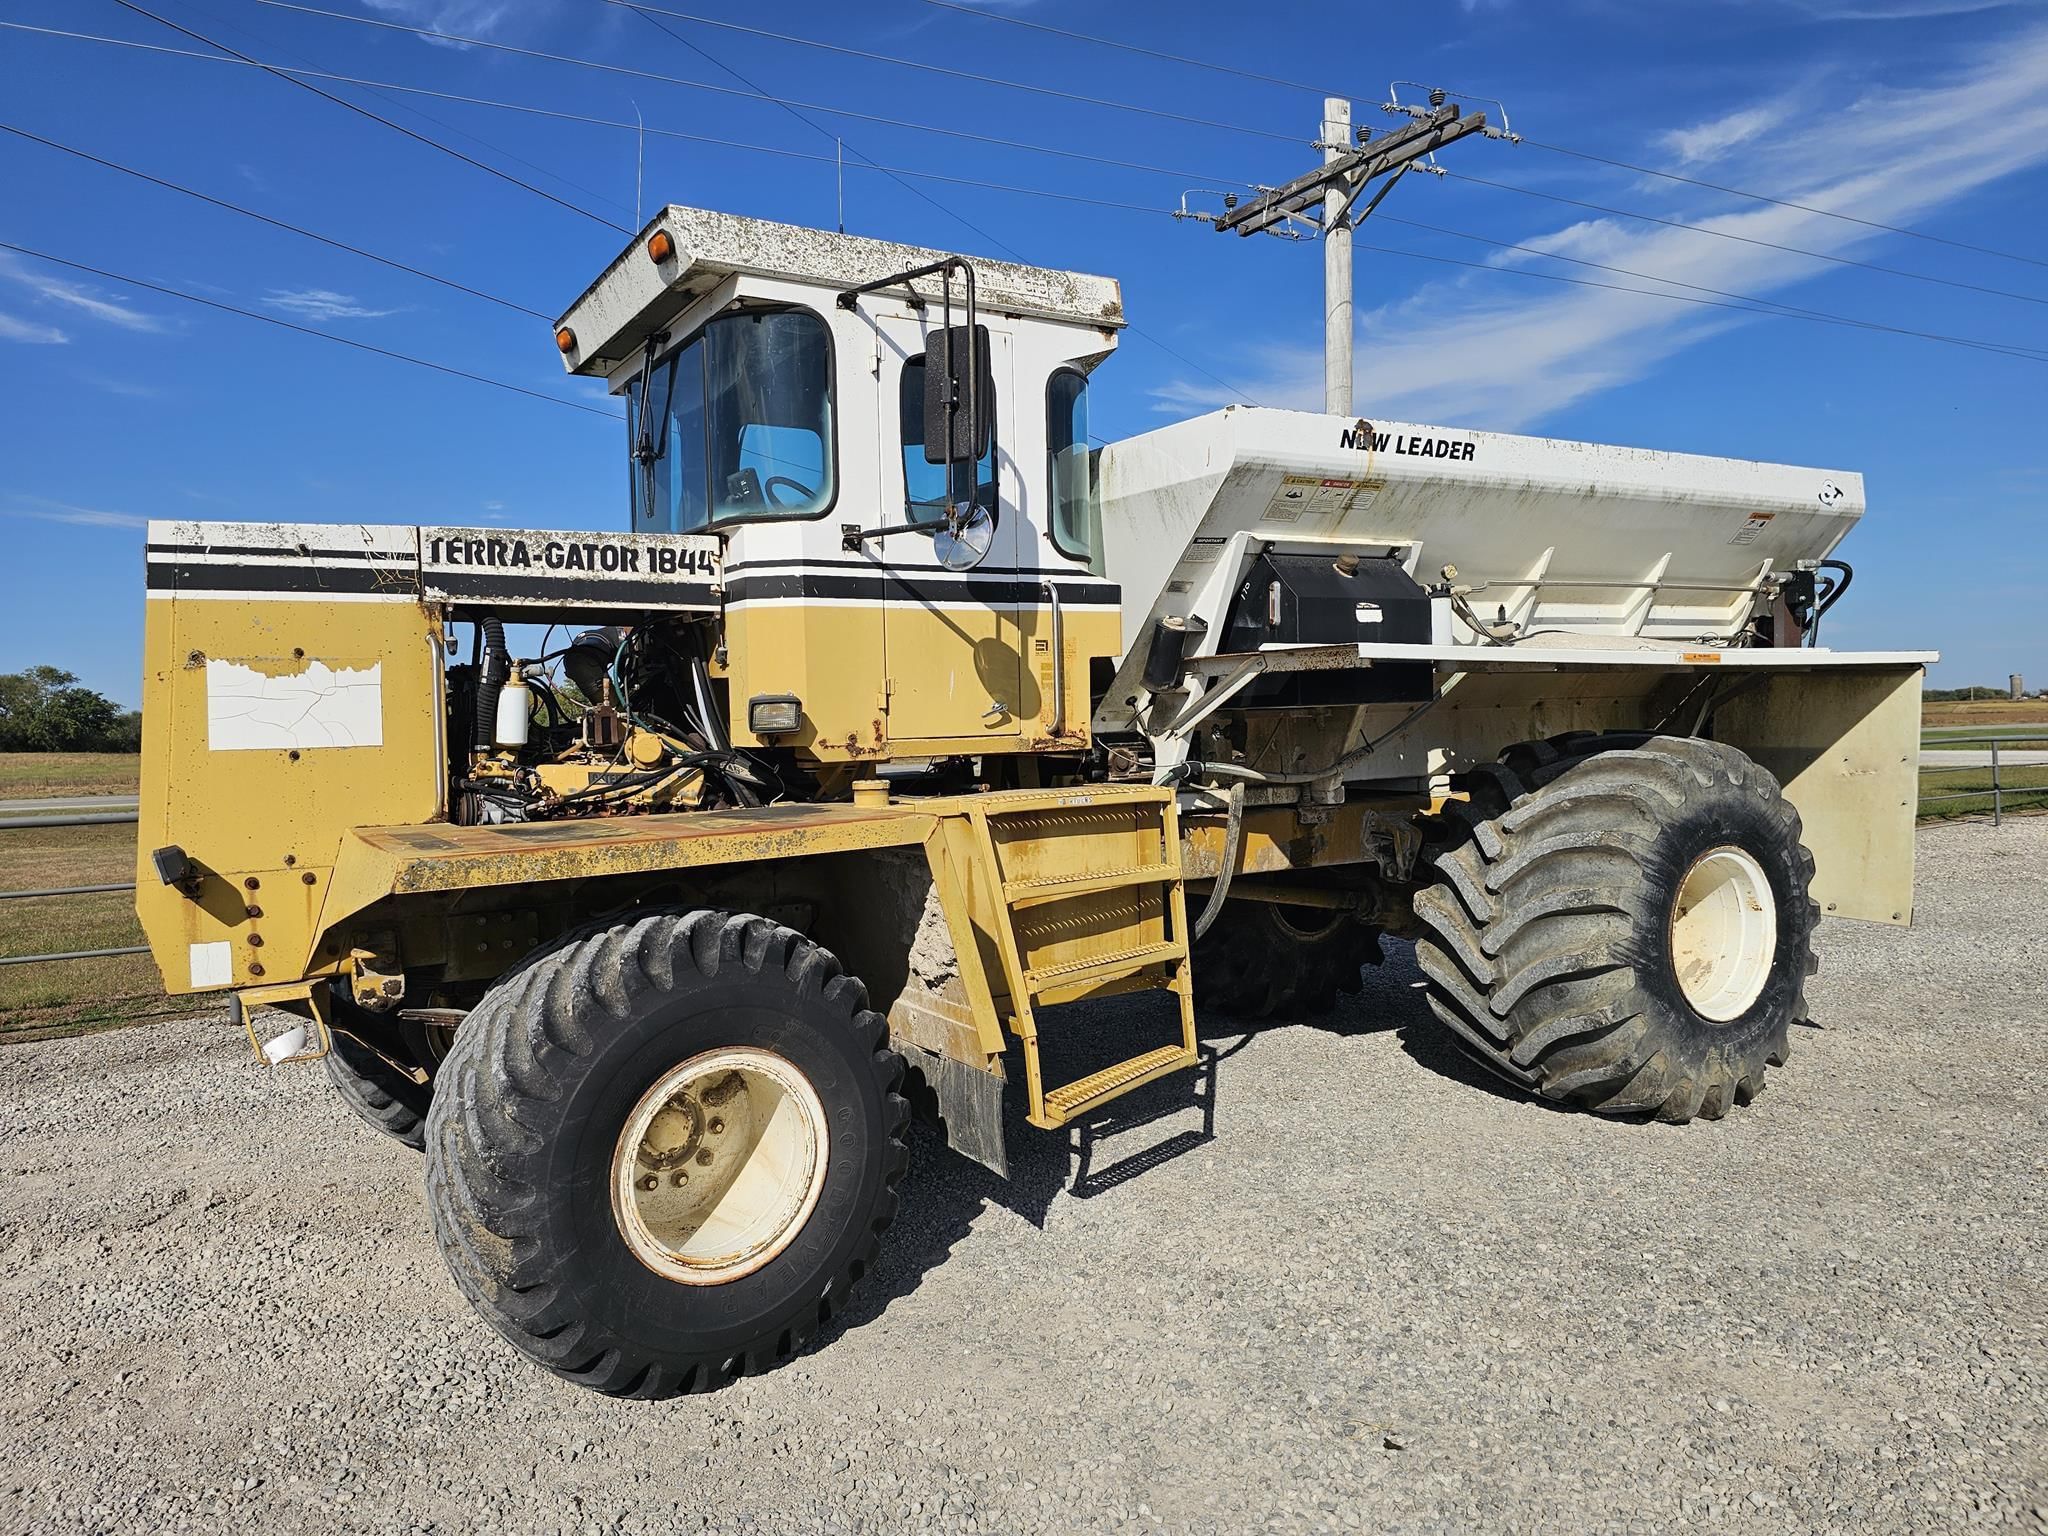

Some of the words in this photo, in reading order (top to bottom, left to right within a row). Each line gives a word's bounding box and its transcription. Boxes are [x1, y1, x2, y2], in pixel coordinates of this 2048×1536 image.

[1340, 429, 1391, 452] NW
[1395, 436, 1476, 461] LEADER
[430, 536, 640, 573] TERRA-GATOR
[649, 546, 715, 576] 1844
[721, 1106, 857, 1315] GOODYEAR
